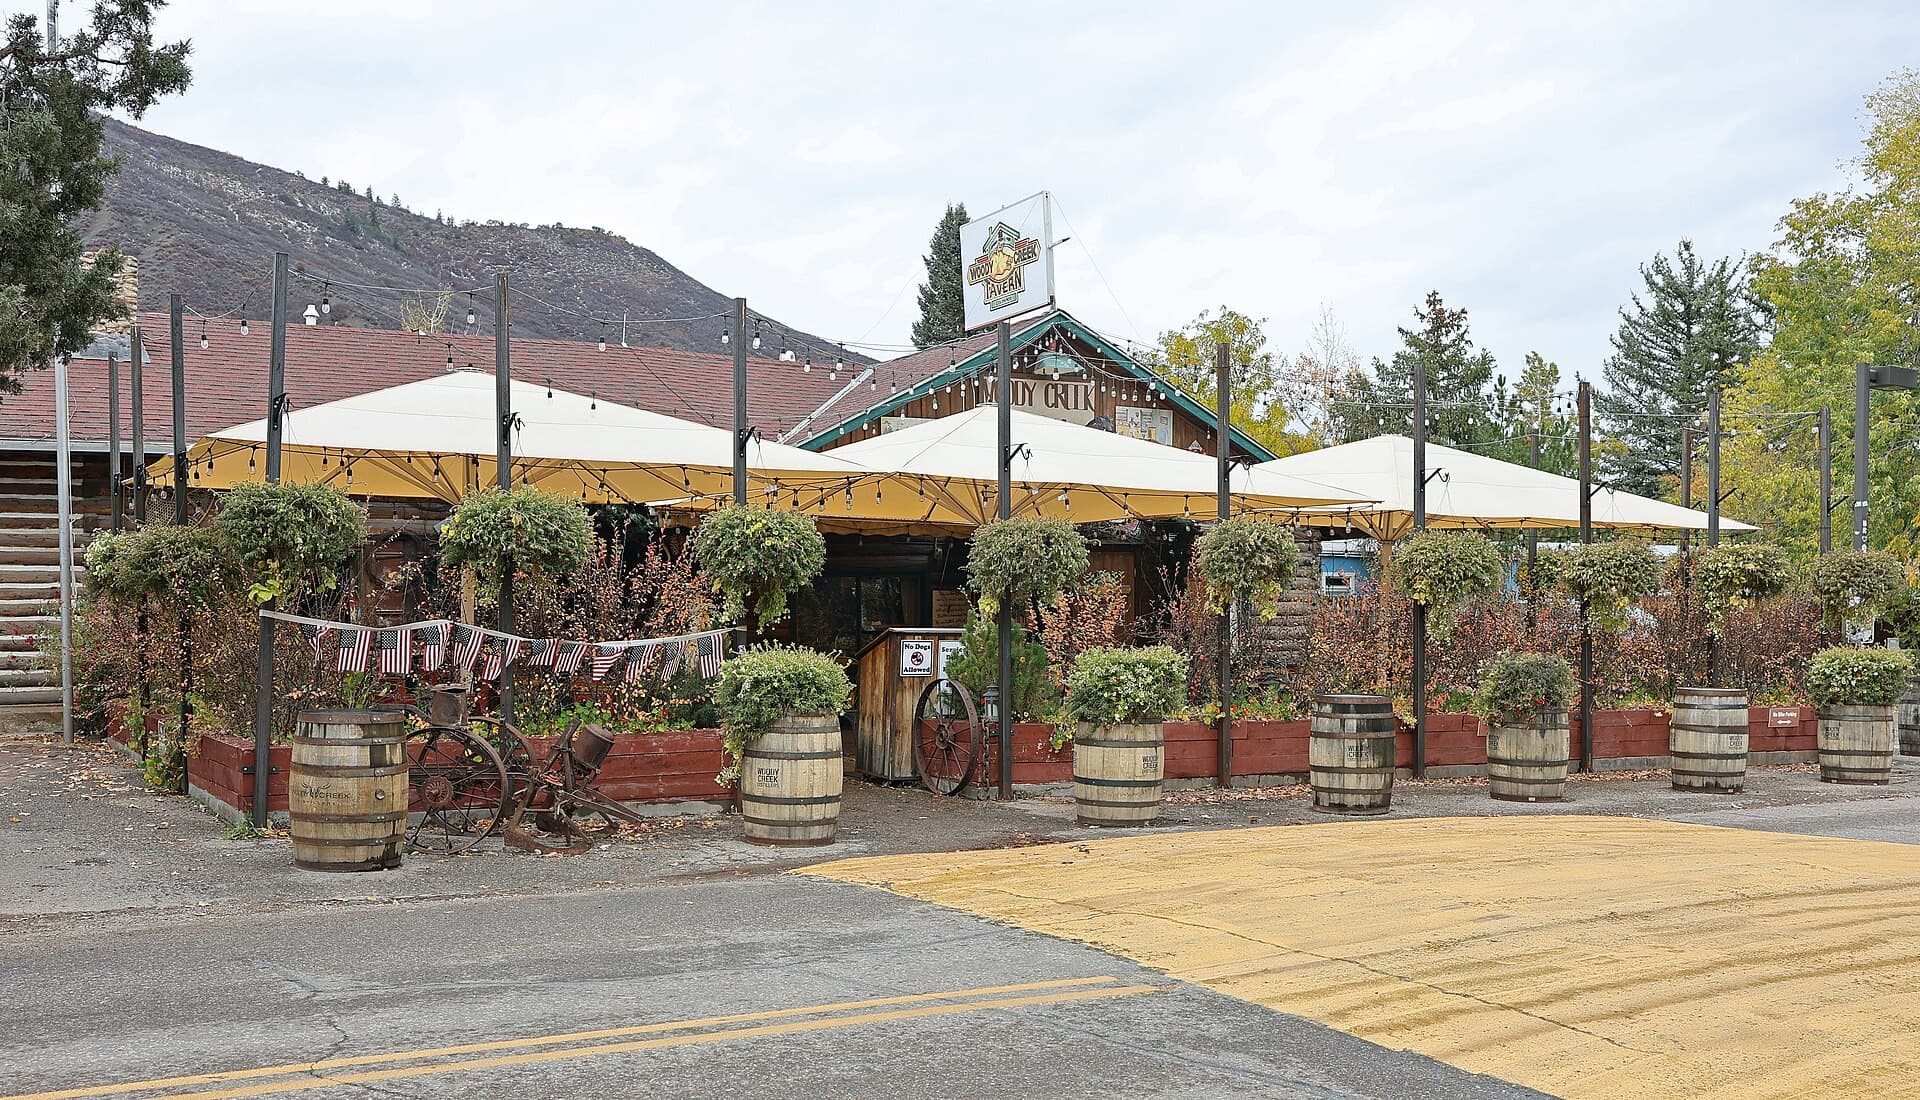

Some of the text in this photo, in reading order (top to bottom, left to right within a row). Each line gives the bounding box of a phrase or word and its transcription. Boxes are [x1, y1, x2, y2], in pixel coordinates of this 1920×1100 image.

[969, 243, 1037, 280] WOODY CREEK
[985, 264, 1022, 299] TAVERN
[914, 643, 930, 651] Dogs
[757, 775, 779, 783] CREEK
[319, 791, 351, 800] CREEK
